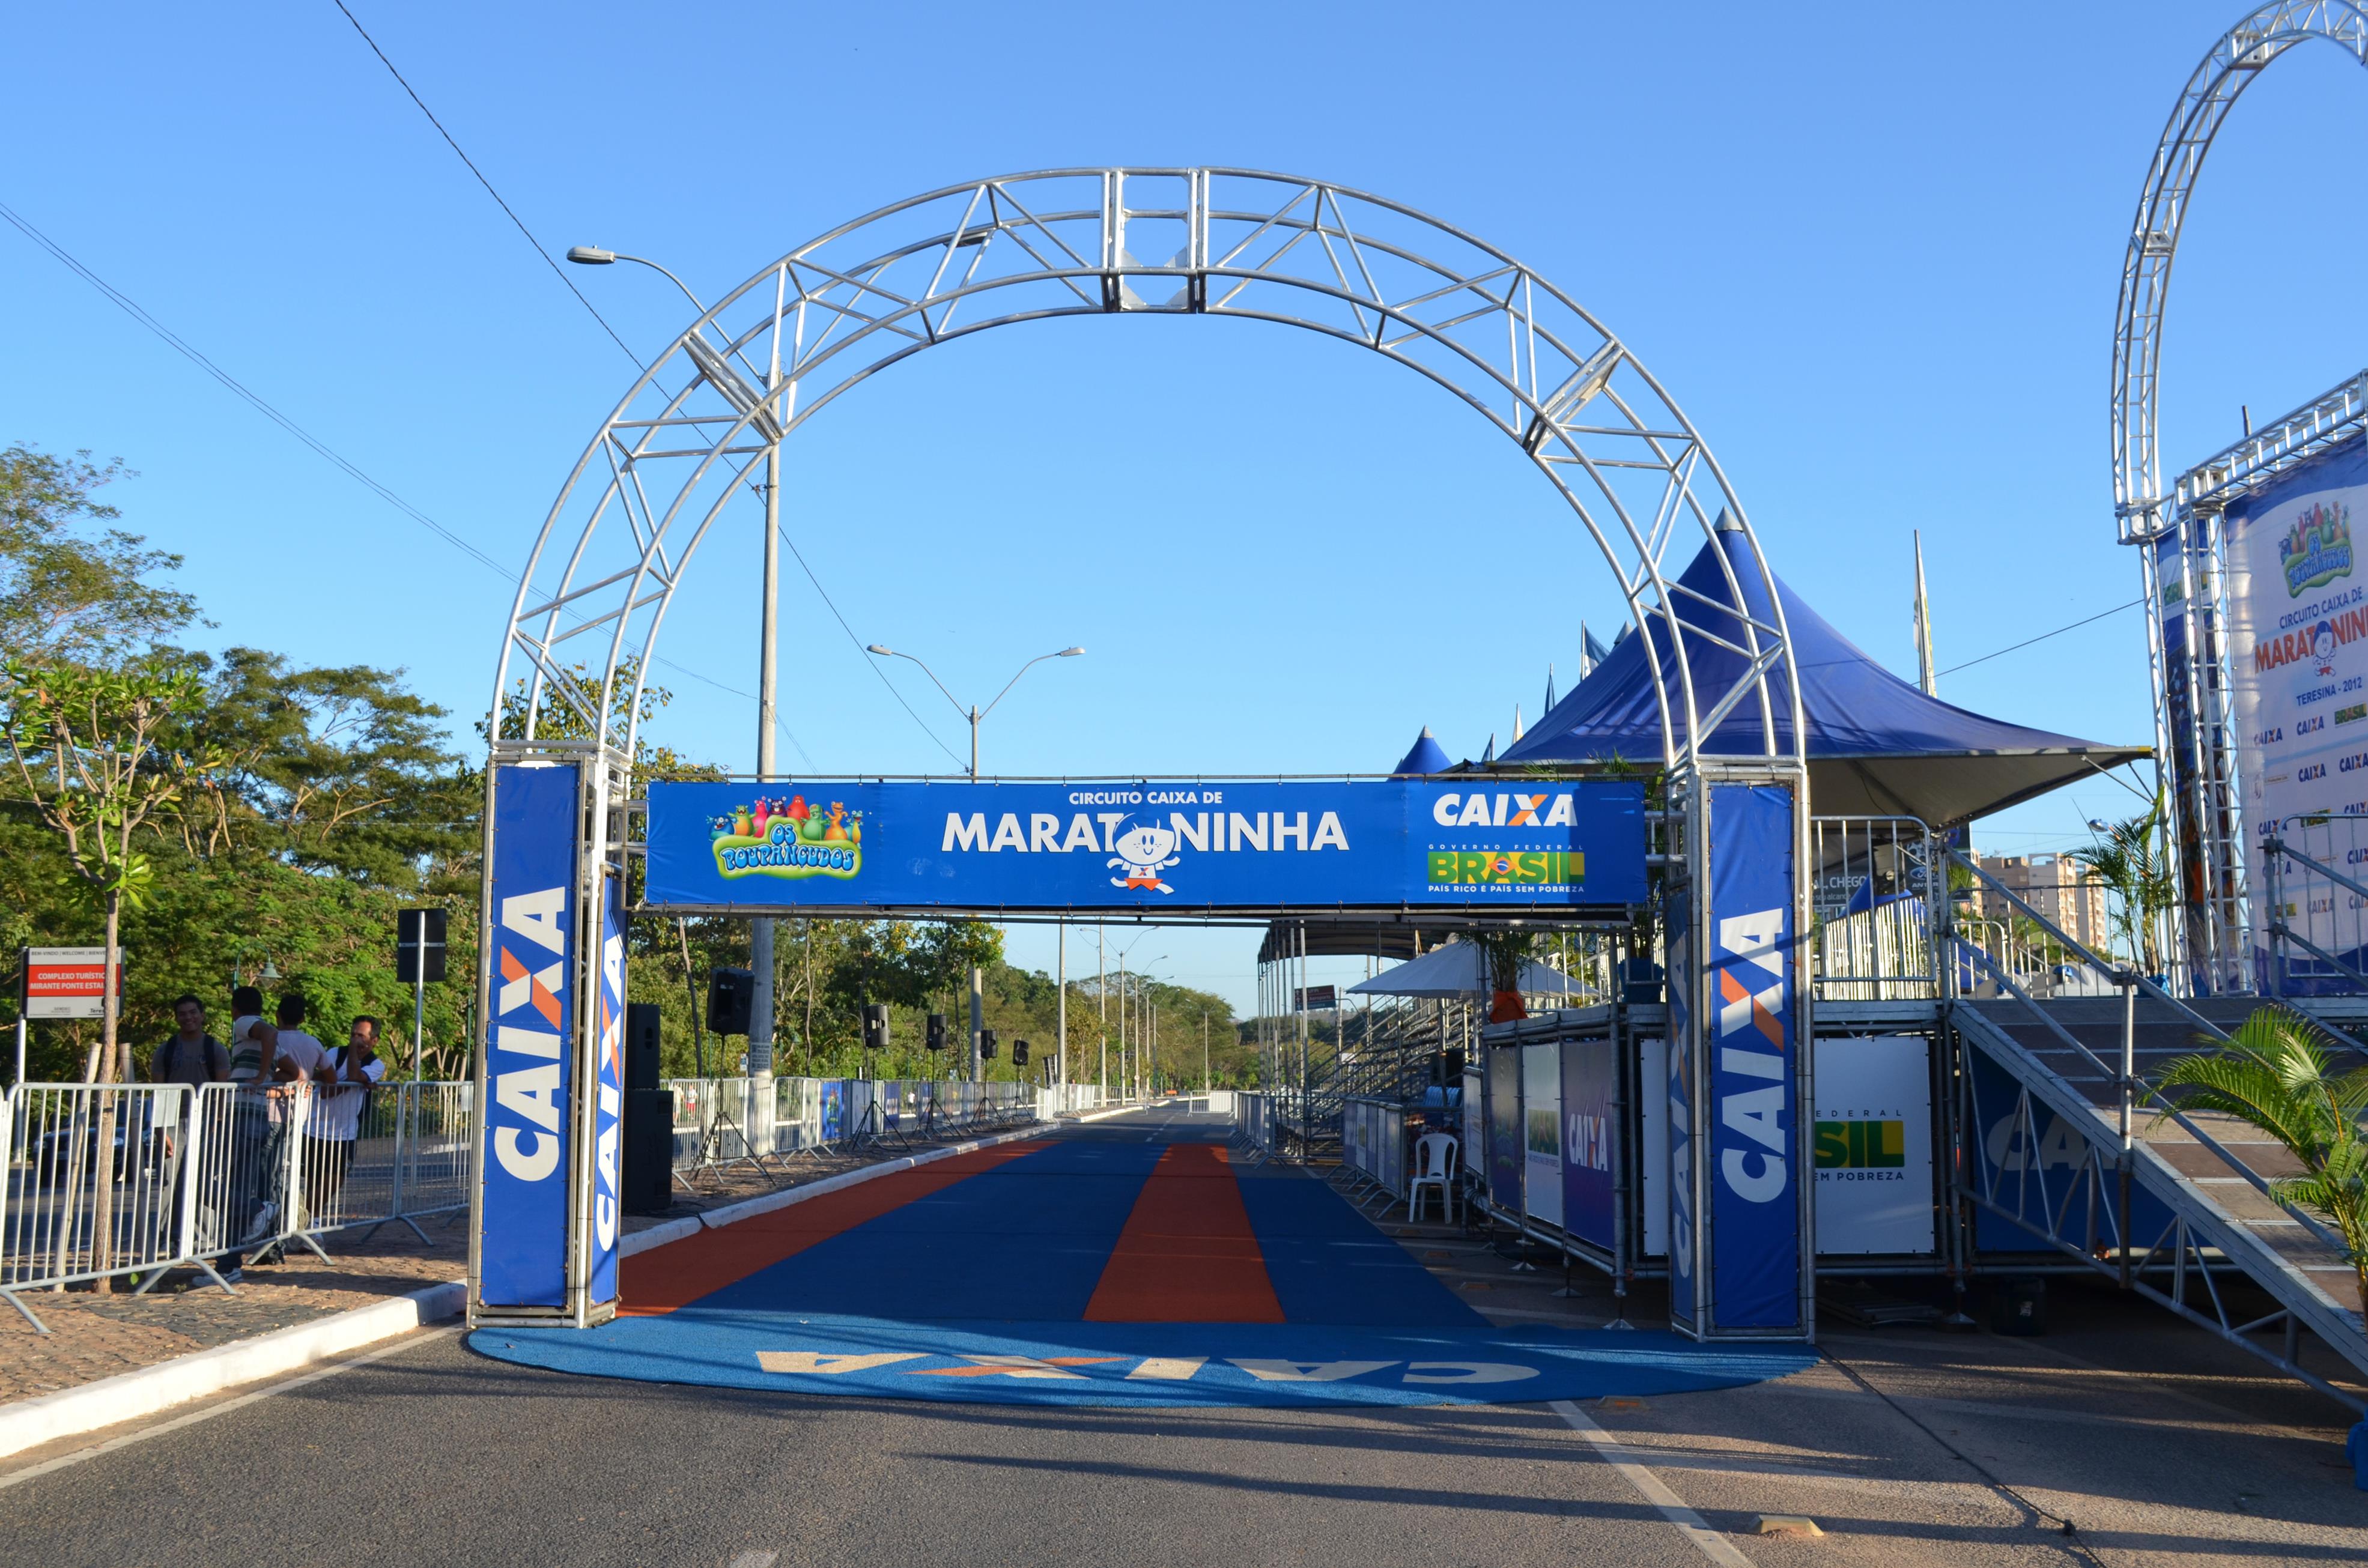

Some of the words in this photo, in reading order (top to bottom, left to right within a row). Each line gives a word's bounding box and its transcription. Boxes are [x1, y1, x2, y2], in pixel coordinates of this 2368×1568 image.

[2279, 604, 2318, 629] CIRCUITO
[2322, 592, 2349, 613] CAIXA
[2351, 586, 2363, 603] DE
[2296, 685, 2336, 706] TERESINA
[2343, 677, 2362, 692] 2012
[2254, 728, 2283, 745] CAIXA
[2297, 716, 2324, 736] CAIXA
[2298, 763, 2326, 782] CAIXA
[1069, 792, 1142, 805] CIRCUITO
[1147, 792, 1198, 804] CAIXA
[1203, 792, 1222, 804] DE
[1433, 793, 1578, 826] CAIXA
[770, 823, 797, 845] OS
[941, 812, 1349, 853] MARATNINHA
[721, 845, 854, 872] POUPANÇUDOS
[1428, 852, 1585, 883] BRASIL
[1830, 875, 1867, 888] CHEGO
[494, 887, 565, 1182] CAIXA
[1720, 908, 1787, 1202] CAIXA
[596, 933, 624, 1252] CAIXA
[1671, 931, 1690, 1278] CAIXA
[1569, 1113, 1608, 1171] CAIXA
[1837, 1172, 1904, 1181] POBREZA
